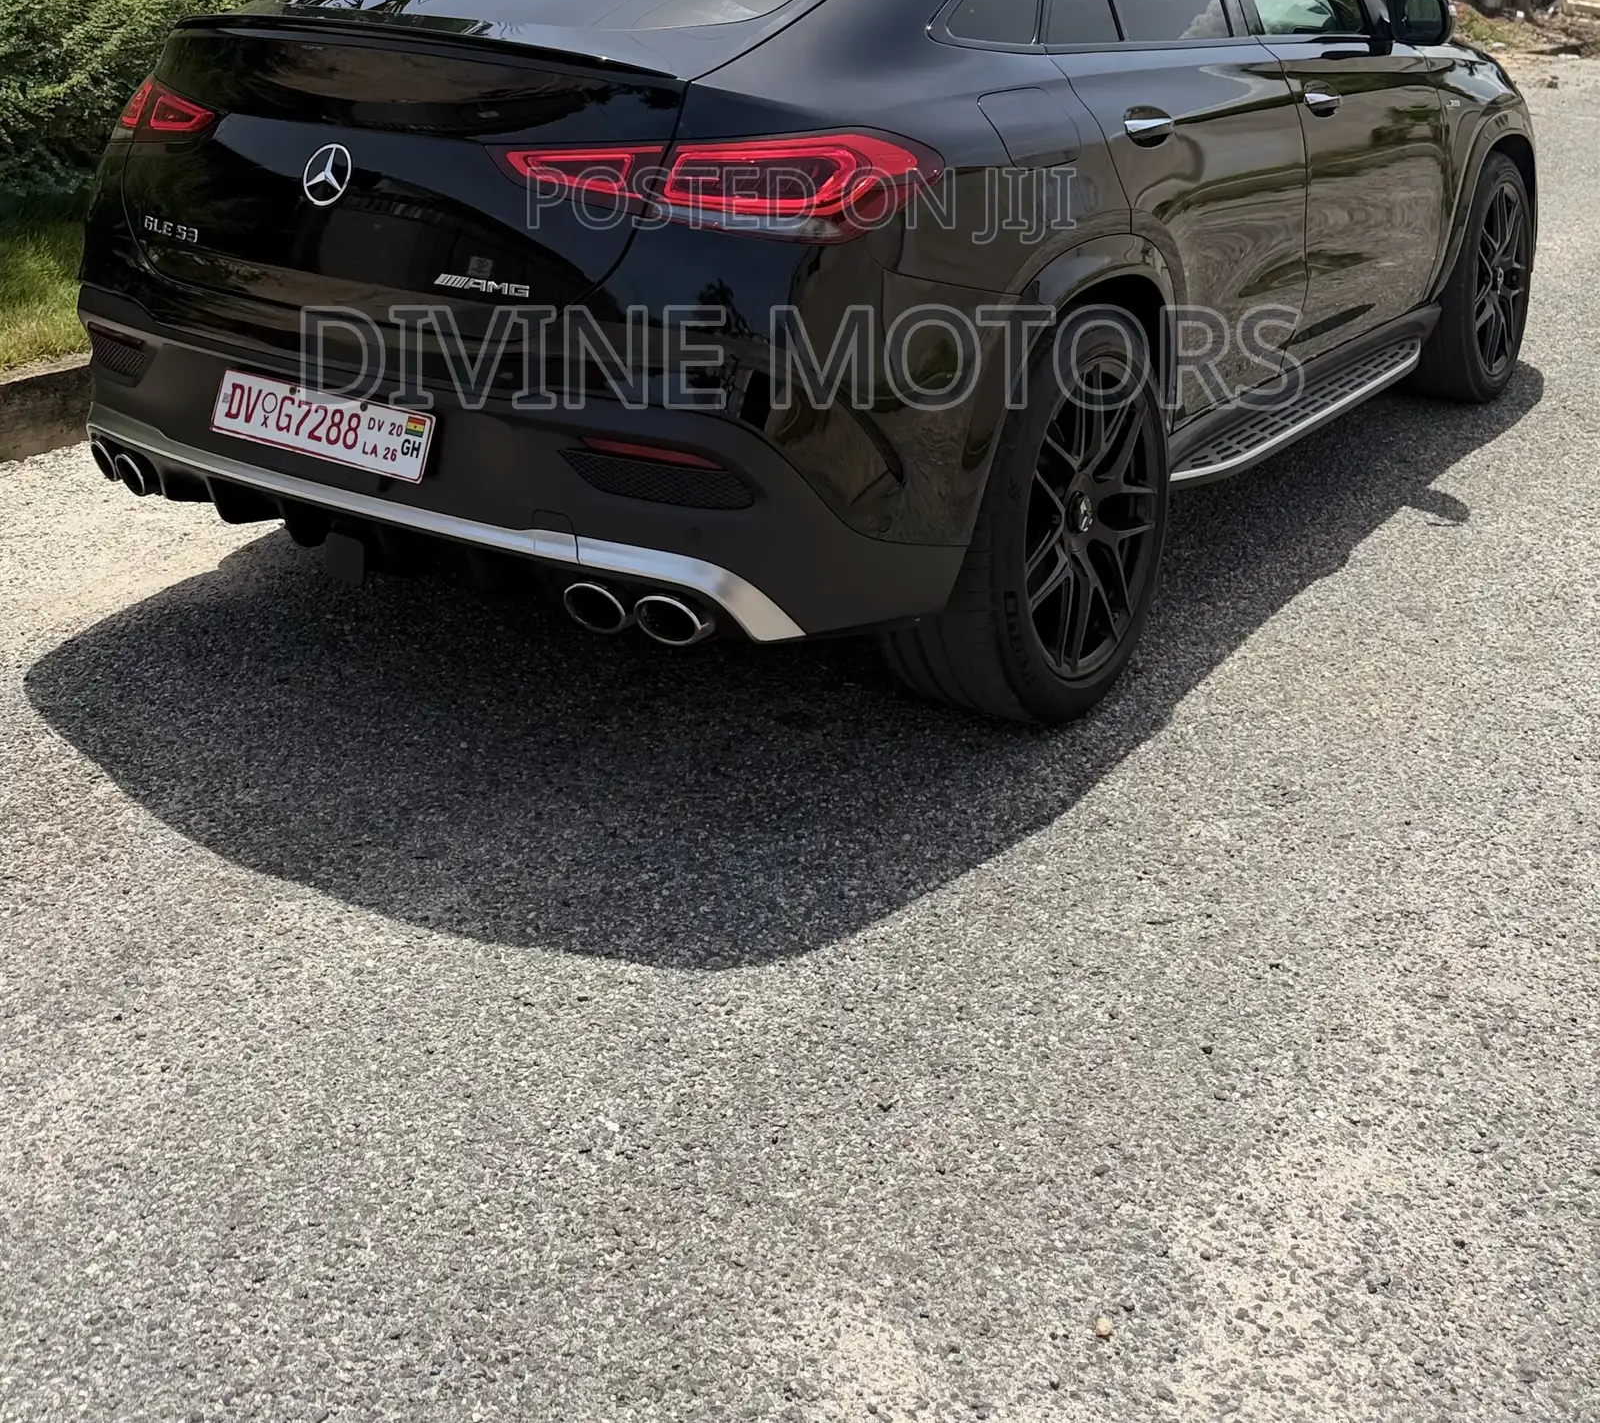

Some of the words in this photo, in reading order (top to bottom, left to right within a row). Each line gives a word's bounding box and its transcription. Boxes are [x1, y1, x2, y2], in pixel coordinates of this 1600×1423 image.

[144, 215, 173, 237] GLE
[175, 224, 198, 243] 53
[463, 277, 530, 298] AMG
[367, 417, 385, 432] DV
[388, 422, 403, 437] 20
[362, 441, 378, 458] LA
[382, 446, 398, 462] 26
[401, 438, 422, 459] GH
